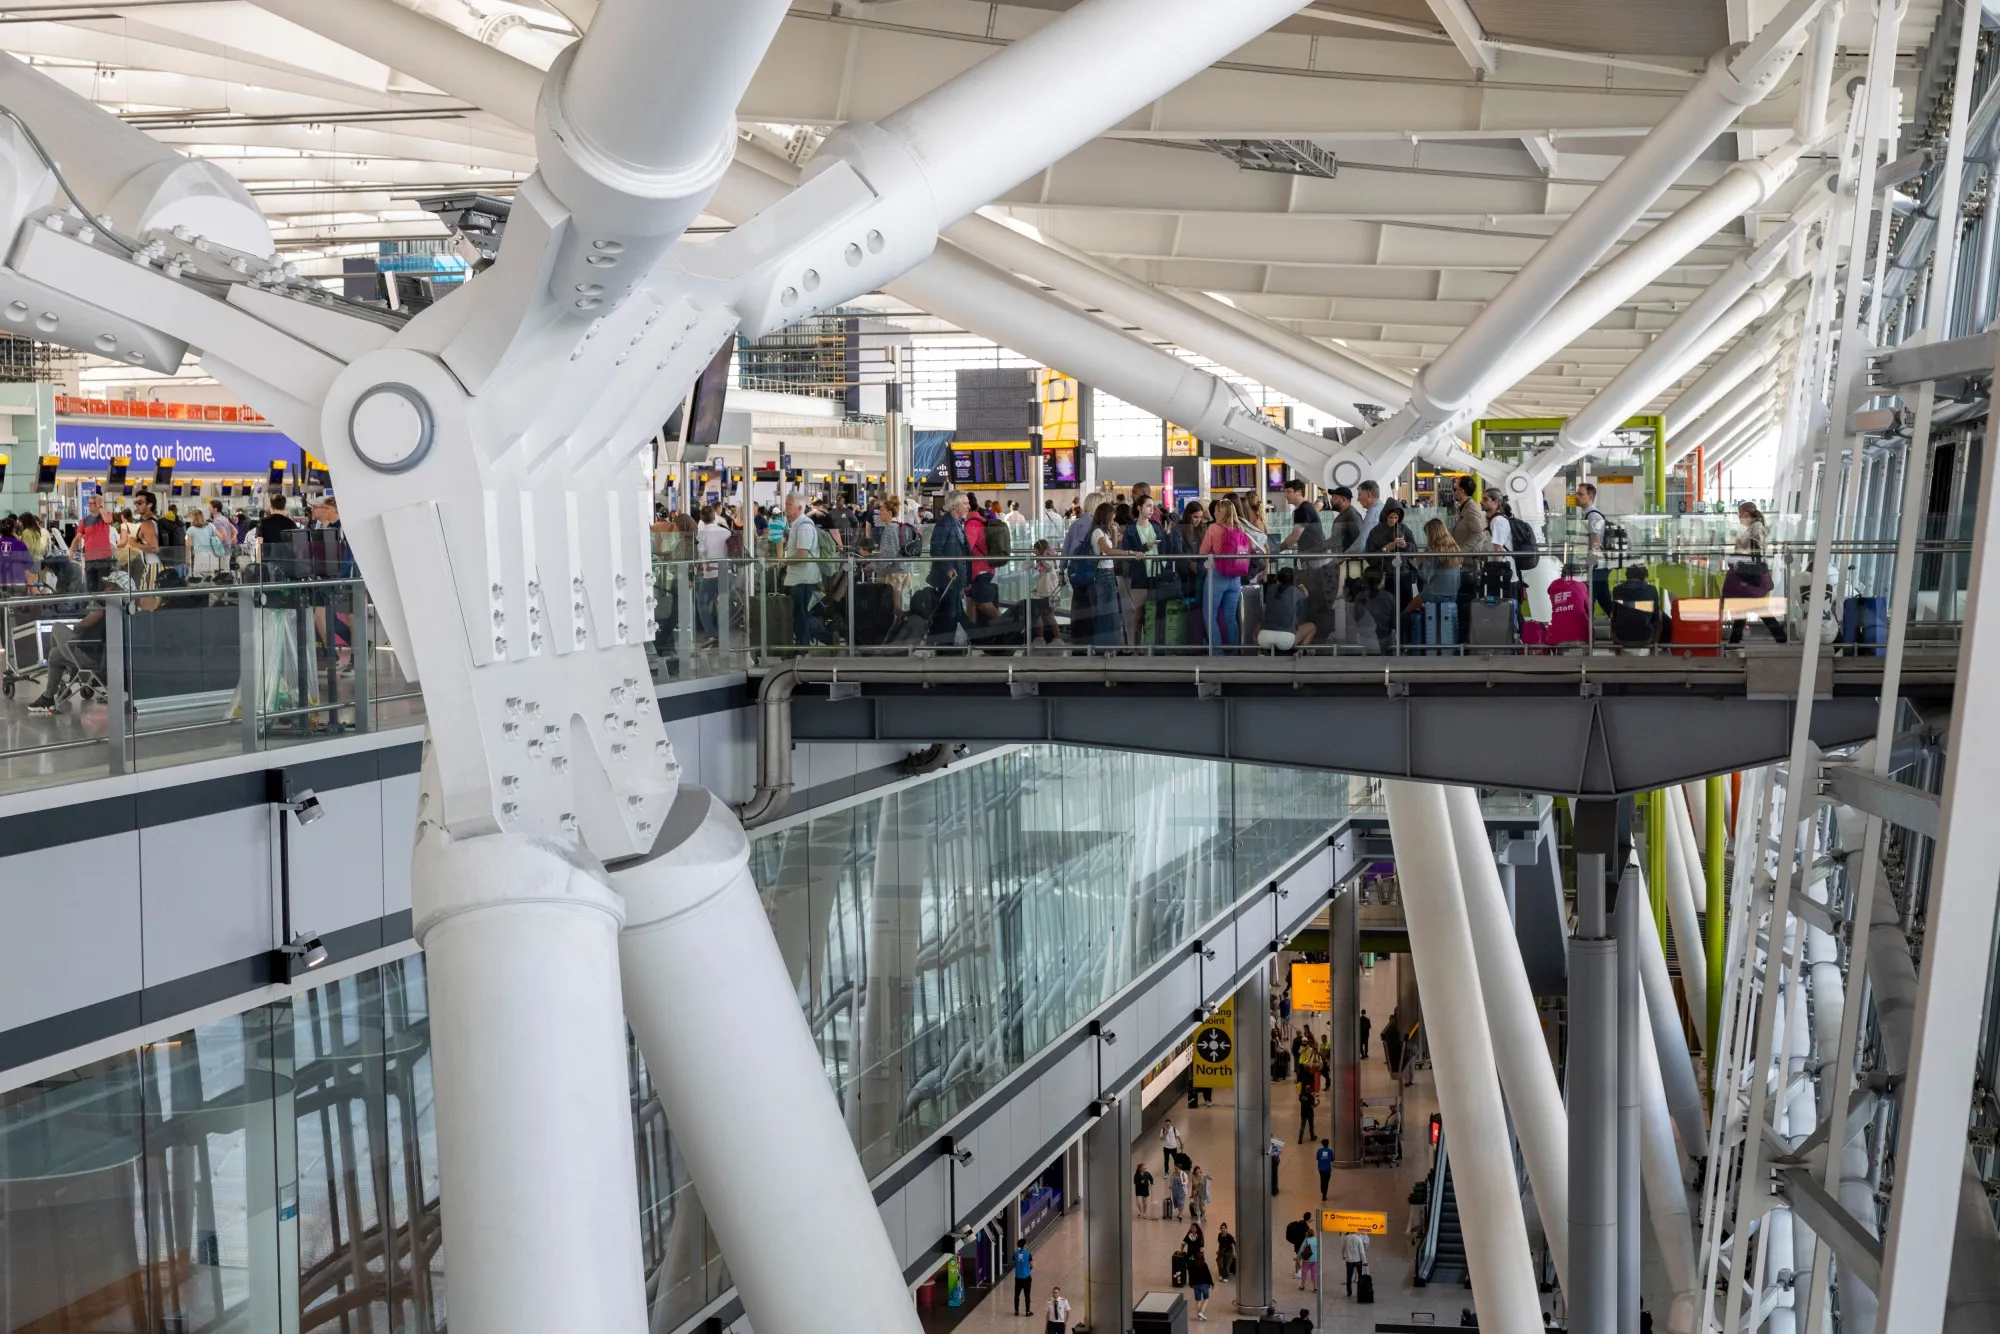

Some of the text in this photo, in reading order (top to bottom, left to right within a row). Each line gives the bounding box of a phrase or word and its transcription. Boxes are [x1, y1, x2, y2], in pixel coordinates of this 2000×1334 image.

[54, 437, 215, 462] arm welcome to our home.
[1554, 591, 1572, 603] EF
[1203, 1017, 1225, 1026] point
[1196, 1065, 1232, 1076] North
